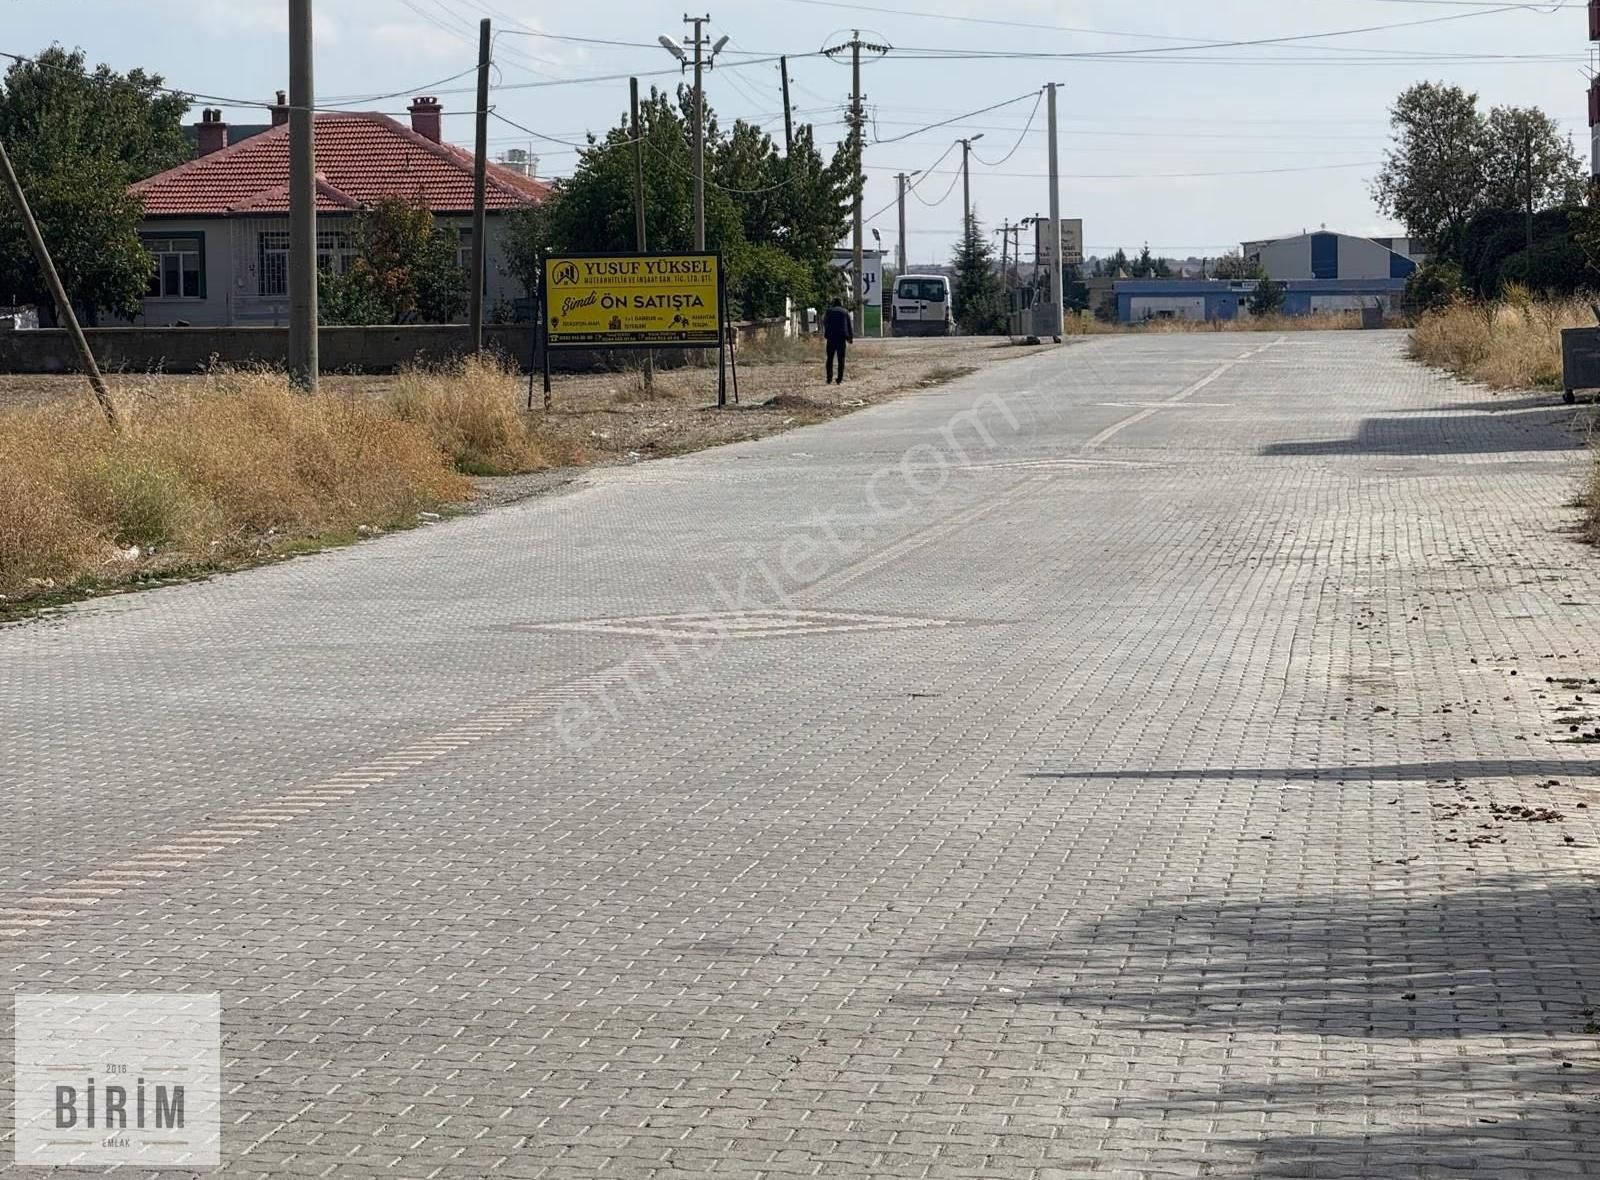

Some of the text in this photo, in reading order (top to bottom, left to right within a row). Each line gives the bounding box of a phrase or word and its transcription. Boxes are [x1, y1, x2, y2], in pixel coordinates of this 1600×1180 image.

[584, 259, 712, 275] YUSUF YÜKSEL
[562, 290, 704, 316] Şimdi ÖN SATIŞTA
